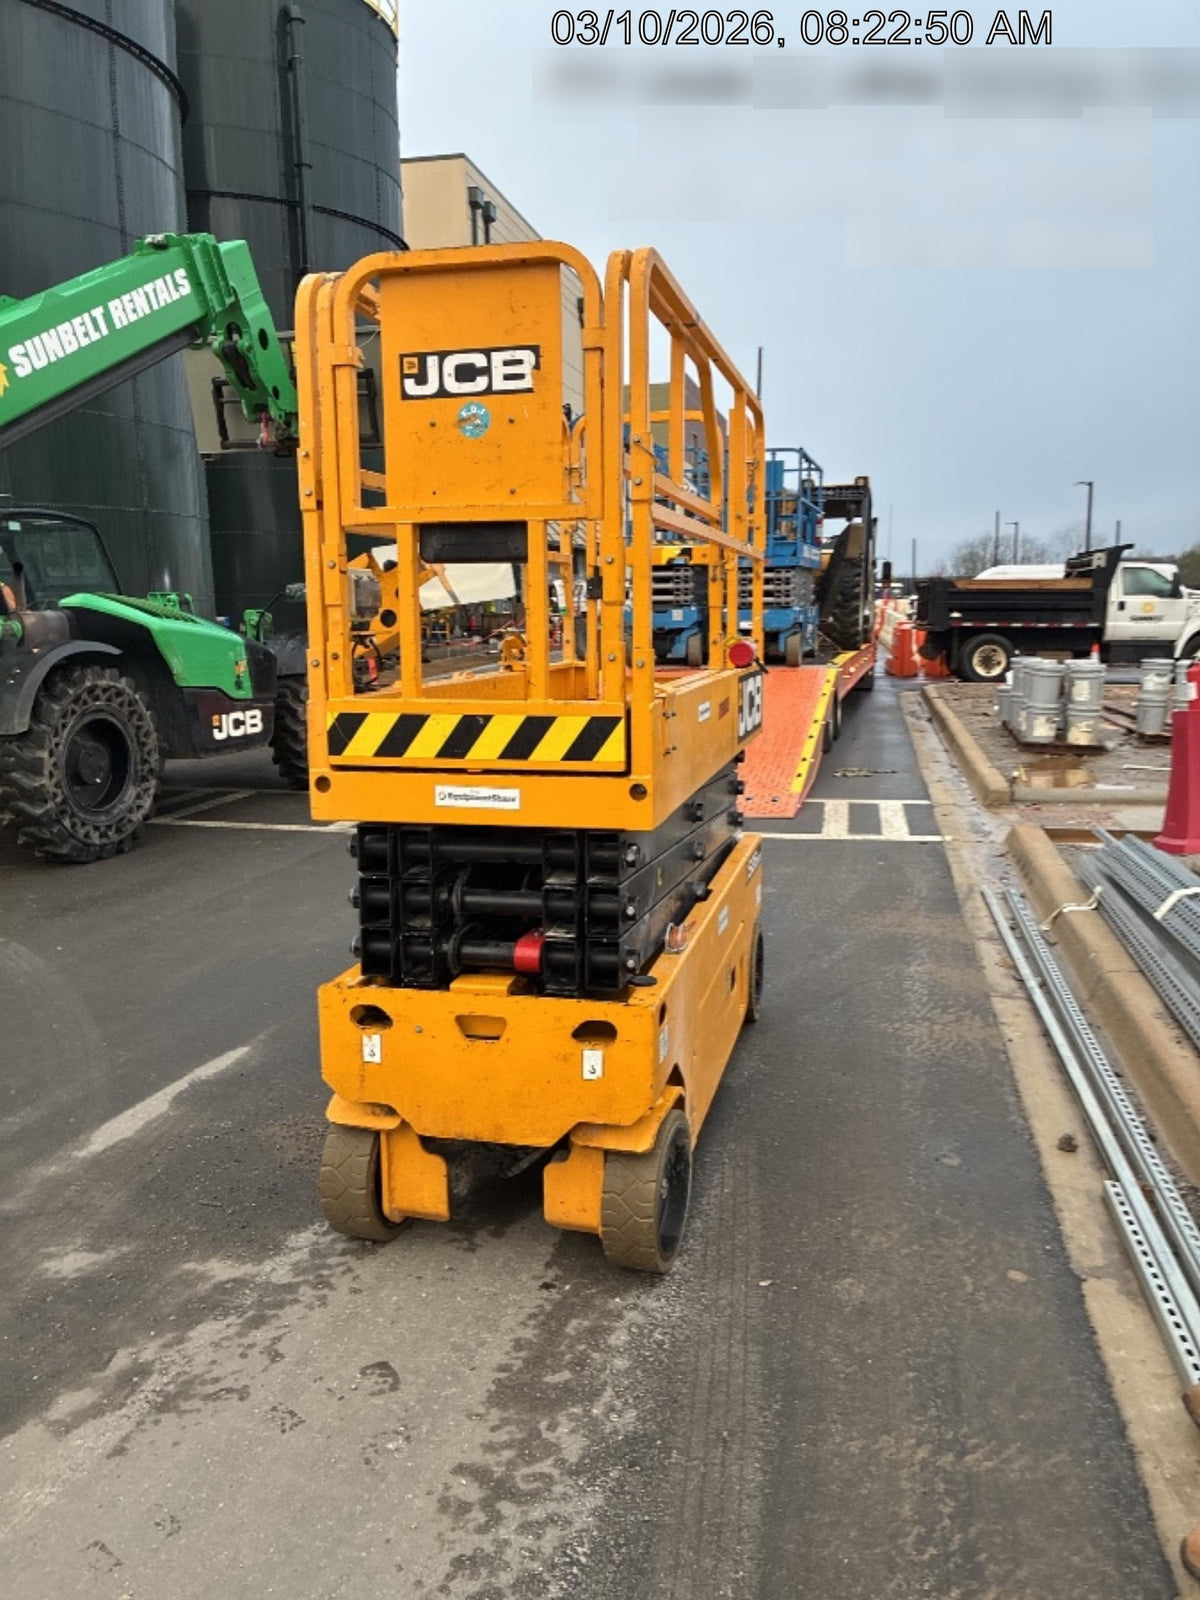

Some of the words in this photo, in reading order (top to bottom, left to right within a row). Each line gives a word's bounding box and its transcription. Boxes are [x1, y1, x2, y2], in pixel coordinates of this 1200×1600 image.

[8, 305, 110, 378] SUNBELT
[107, 267, 192, 330] RENTALS
[402, 349, 537, 396] JCB
[213, 708, 264, 741] JCB
[738, 674, 763, 738] JCB
